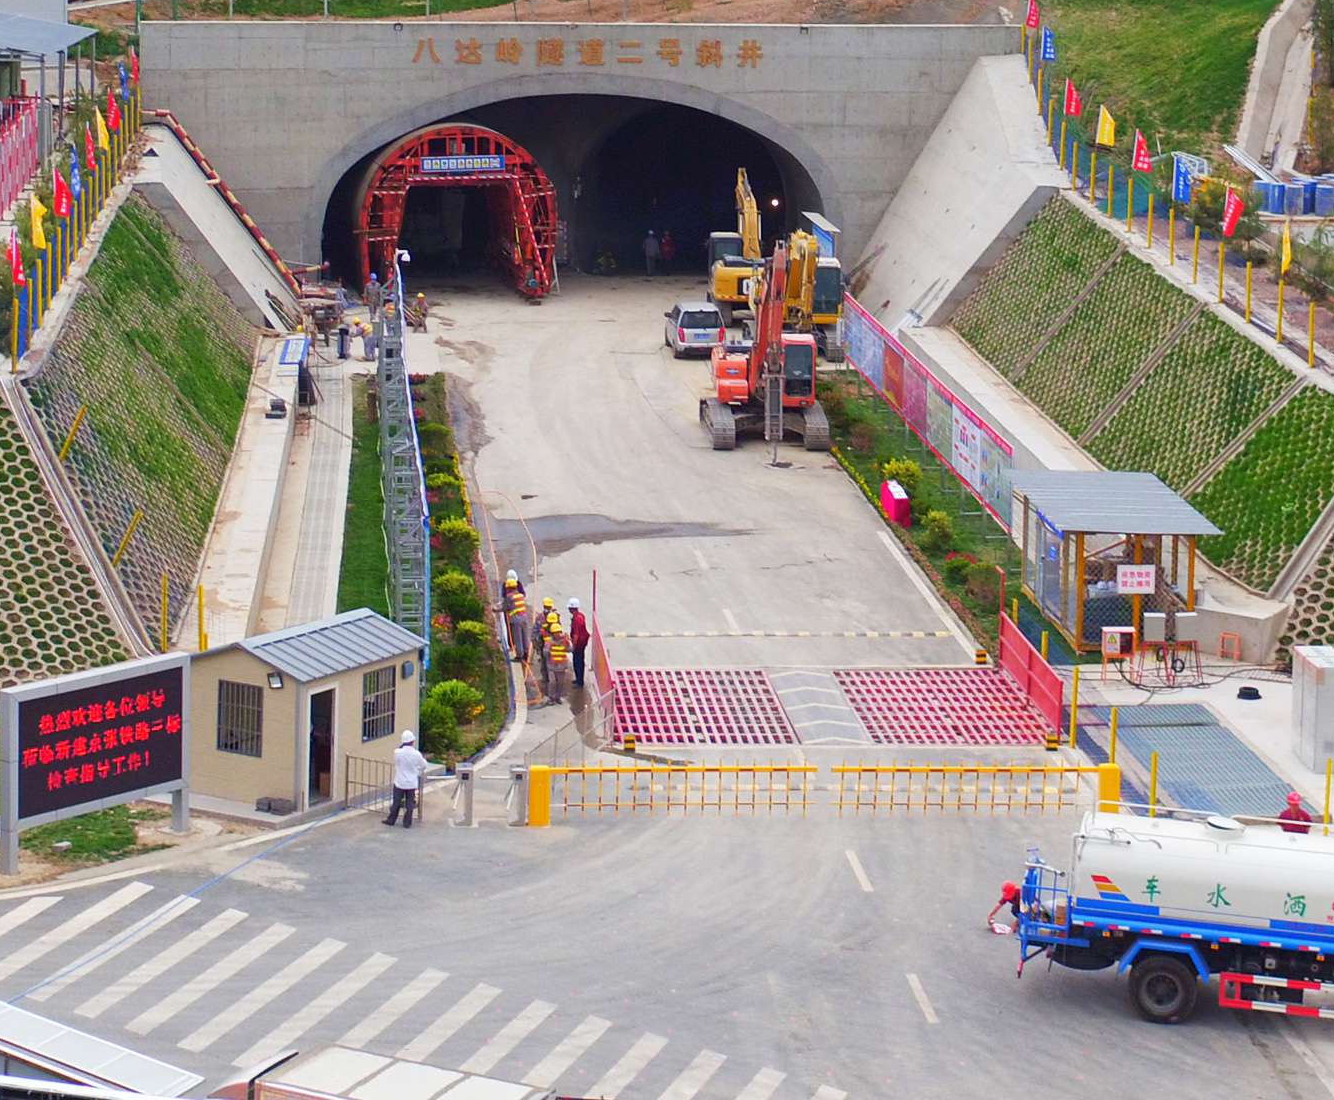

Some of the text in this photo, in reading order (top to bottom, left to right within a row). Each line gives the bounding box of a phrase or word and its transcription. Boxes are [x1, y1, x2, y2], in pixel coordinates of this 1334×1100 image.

[413, 37, 764, 68] 八达岭隧道二号斜井
